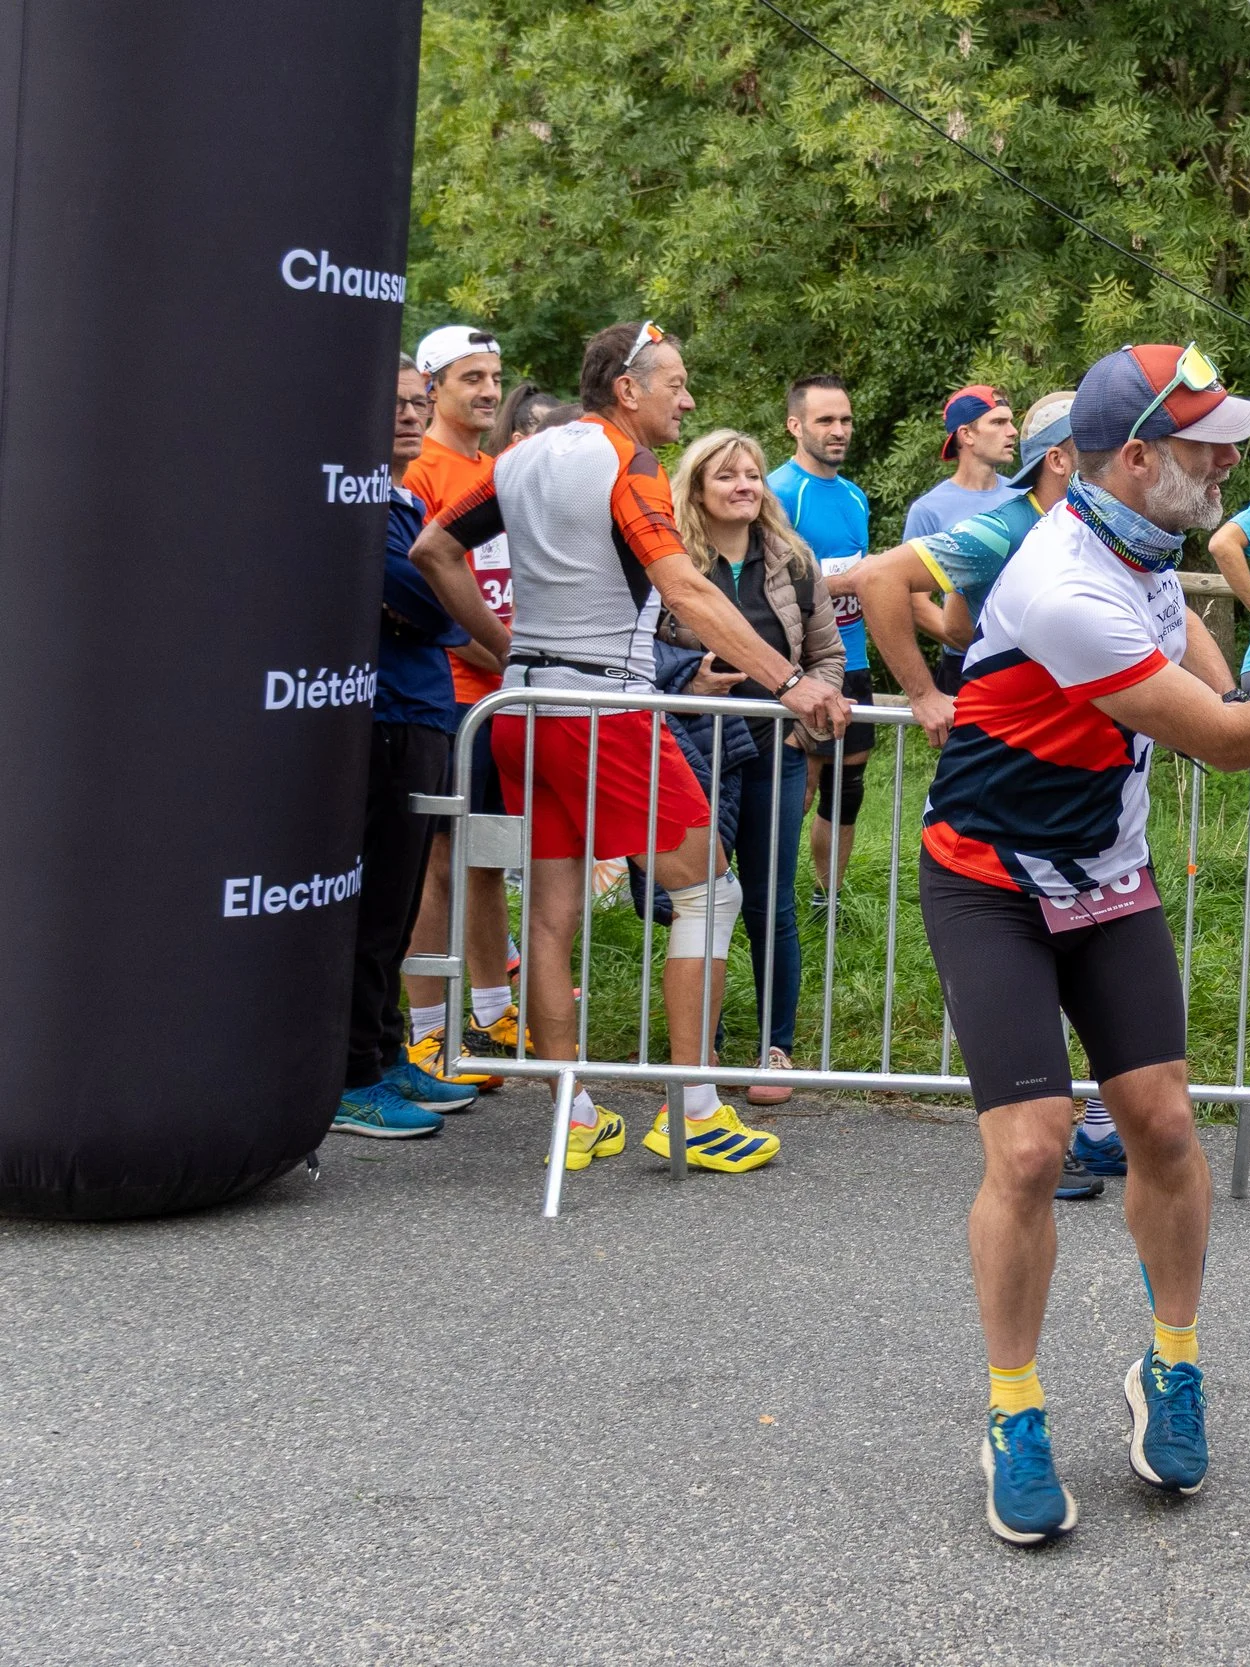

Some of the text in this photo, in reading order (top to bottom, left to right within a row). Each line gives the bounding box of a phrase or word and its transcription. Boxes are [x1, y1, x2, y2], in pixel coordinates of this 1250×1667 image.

[322, 463, 392, 504] Textile
[832, 595, 862, 617] 28
[1015, 1077, 1047, 1086] EVADICT
